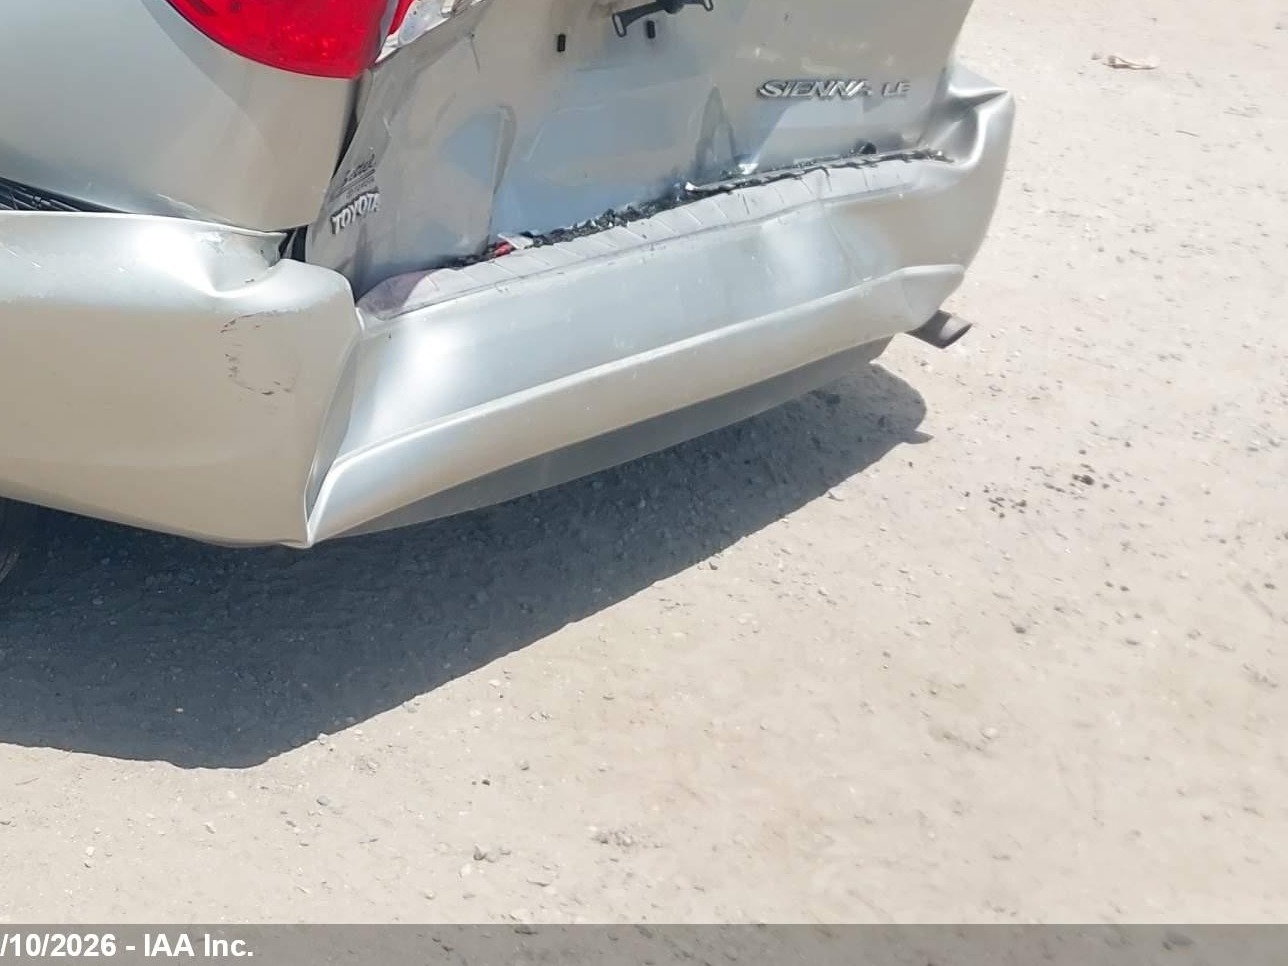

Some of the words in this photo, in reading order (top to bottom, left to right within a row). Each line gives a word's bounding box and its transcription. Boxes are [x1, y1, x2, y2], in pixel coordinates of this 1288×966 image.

[759, 80, 873, 99] SIENNA
[881, 82, 911, 97] LE
[331, 192, 380, 234] TOYOTA
